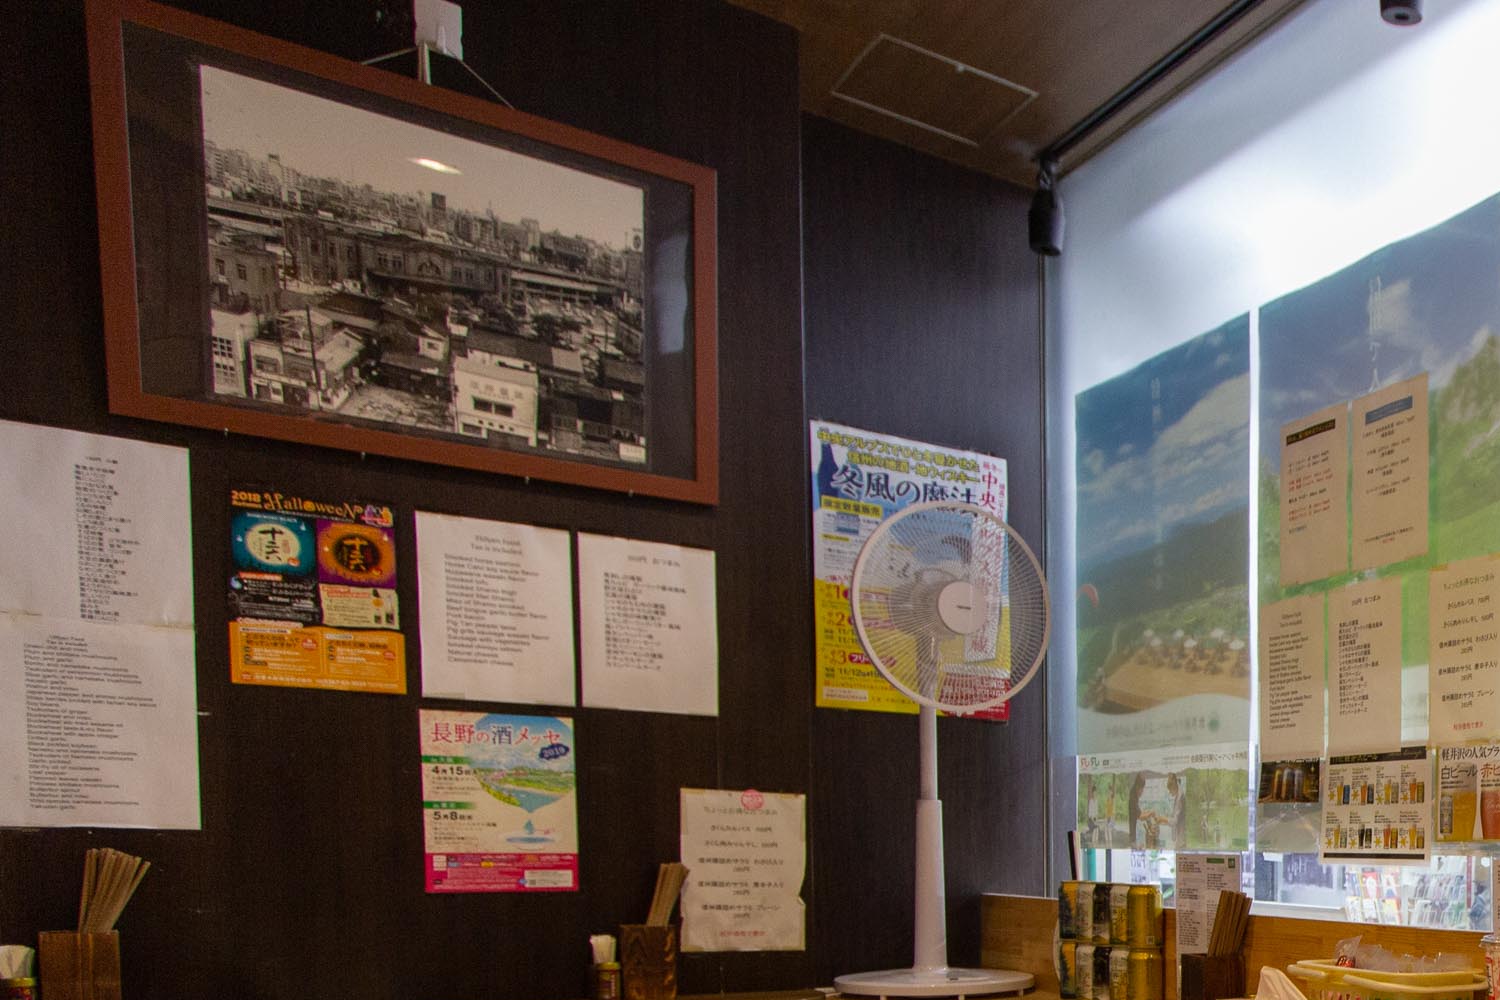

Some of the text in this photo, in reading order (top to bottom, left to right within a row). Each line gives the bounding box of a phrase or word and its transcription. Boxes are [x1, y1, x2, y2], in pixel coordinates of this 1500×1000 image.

[431, 723, 561, 745] 長野の酒メッセ
[1441, 763, 1477, 780] 白ビール
